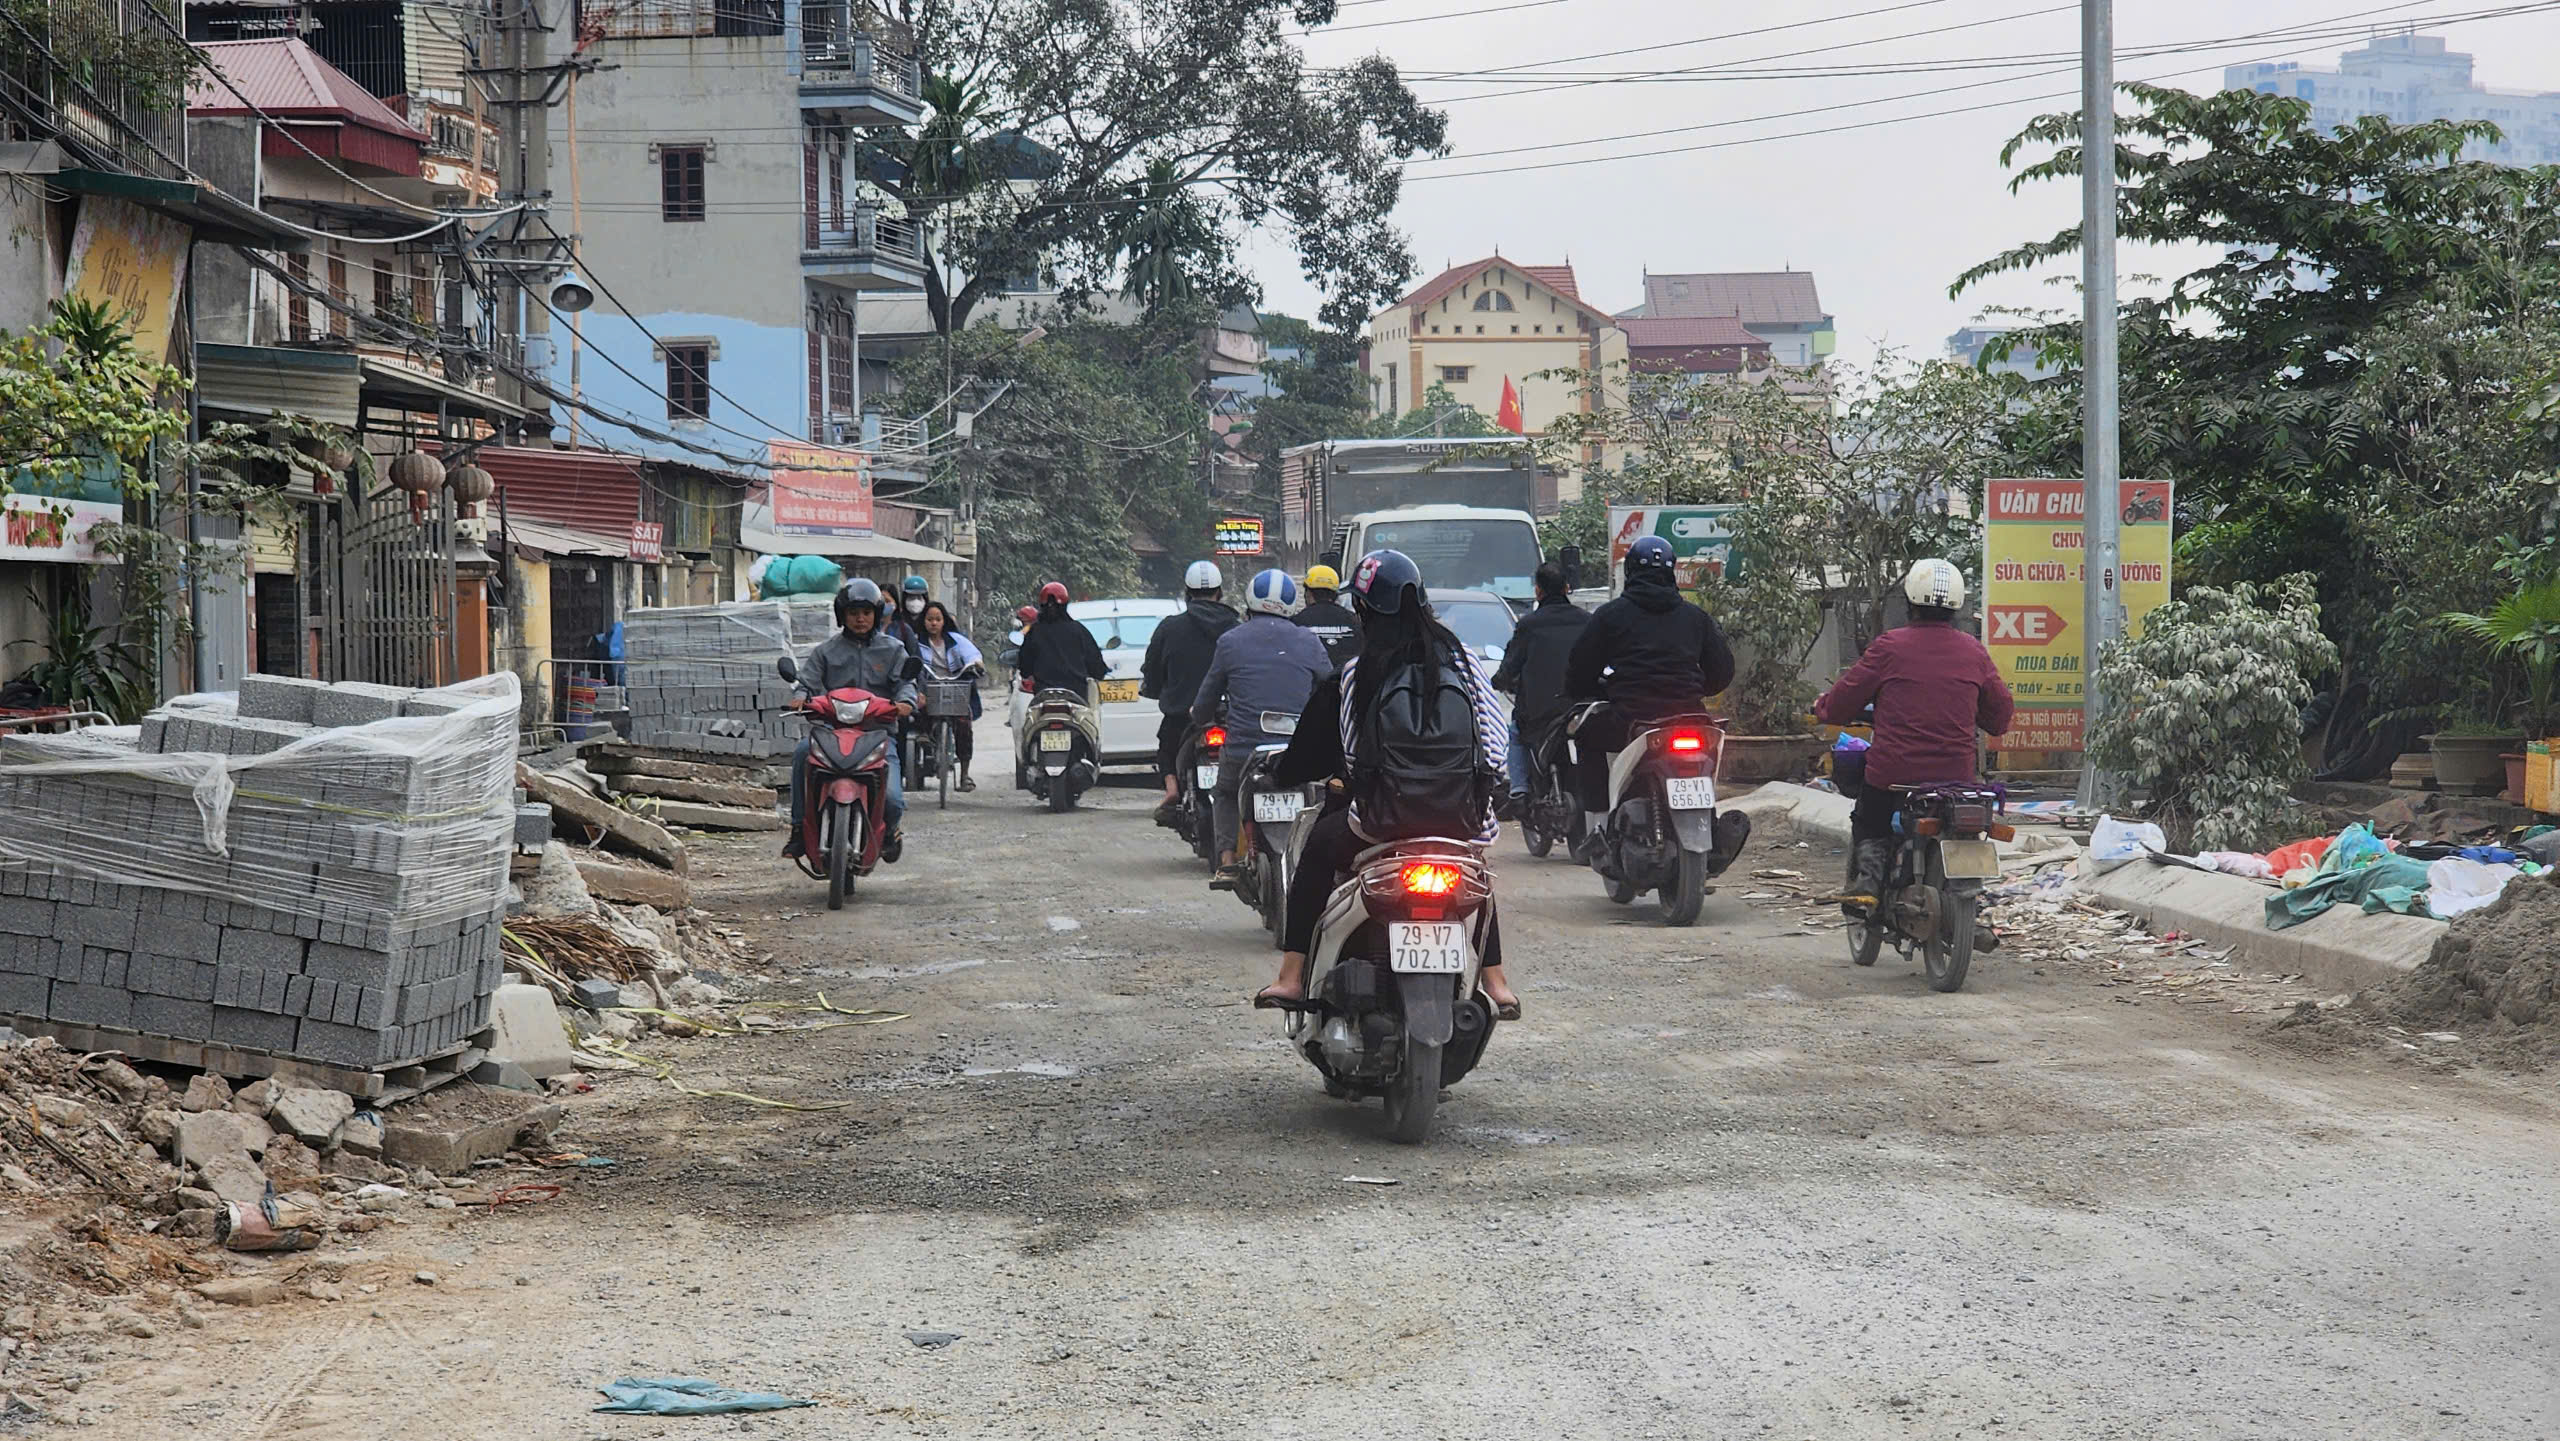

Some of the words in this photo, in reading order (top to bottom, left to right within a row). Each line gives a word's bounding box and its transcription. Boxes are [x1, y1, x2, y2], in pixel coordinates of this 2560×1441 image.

[1406, 443, 1452, 454] ISUZU
[2000, 488, 2040, 514] VĂN
[2046, 491, 2084, 514] CHU
[2052, 531, 2084, 548] CHUY
[1995, 558, 2024, 581] SỬA
[2028, 559, 2066, 581] CHỮA
[1992, 612, 2048, 639] XE
[2015, 655, 2047, 671] MUA
[2051, 652, 2080, 671] BÁN
[2016, 681, 2043, 694] MÁY
[2056, 683, 2072, 694] XE
[2033, 710, 2050, 726] NGÔ
[1674, 780, 1705, 793] 29-V1
[1262, 794, 1296, 807] 29-V7
[1672, 793, 1711, 807] 656.19
[1258, 807, 1299, 820] 051.3
[1401, 926, 1452, 946] 29-V7
[1396, 949, 1460, 969] 702.13
